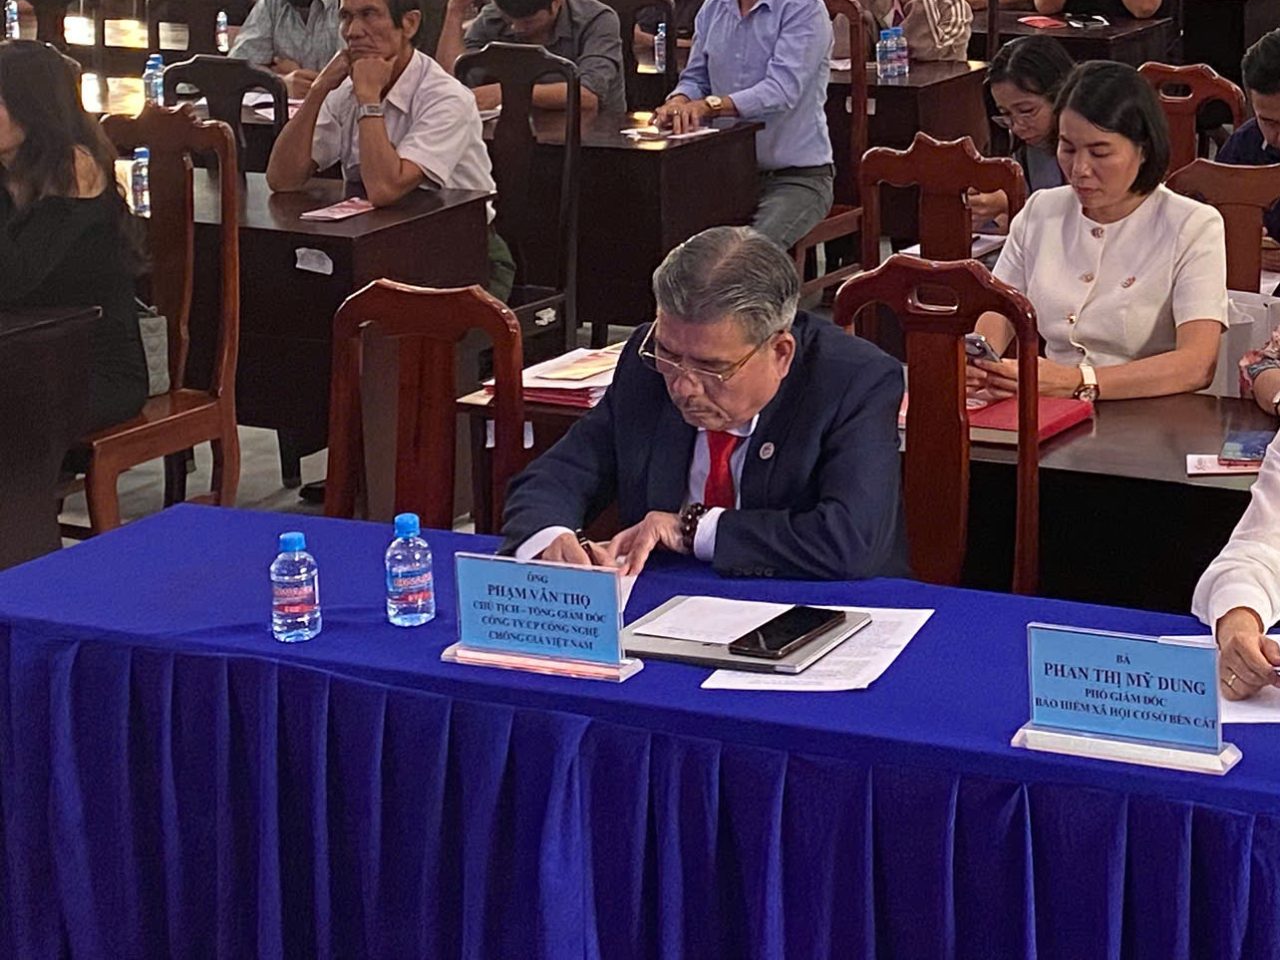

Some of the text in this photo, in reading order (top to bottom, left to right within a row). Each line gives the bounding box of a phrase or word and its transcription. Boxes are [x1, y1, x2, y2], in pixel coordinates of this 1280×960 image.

[488, 584, 591, 609] PHẠM VĂN THỌ
[1116, 653, 1131, 664] BÀ
[1044, 662, 1206, 695] PHAN THỊ MỸ DUNG
[1085, 687, 1108, 700] PHÓ
